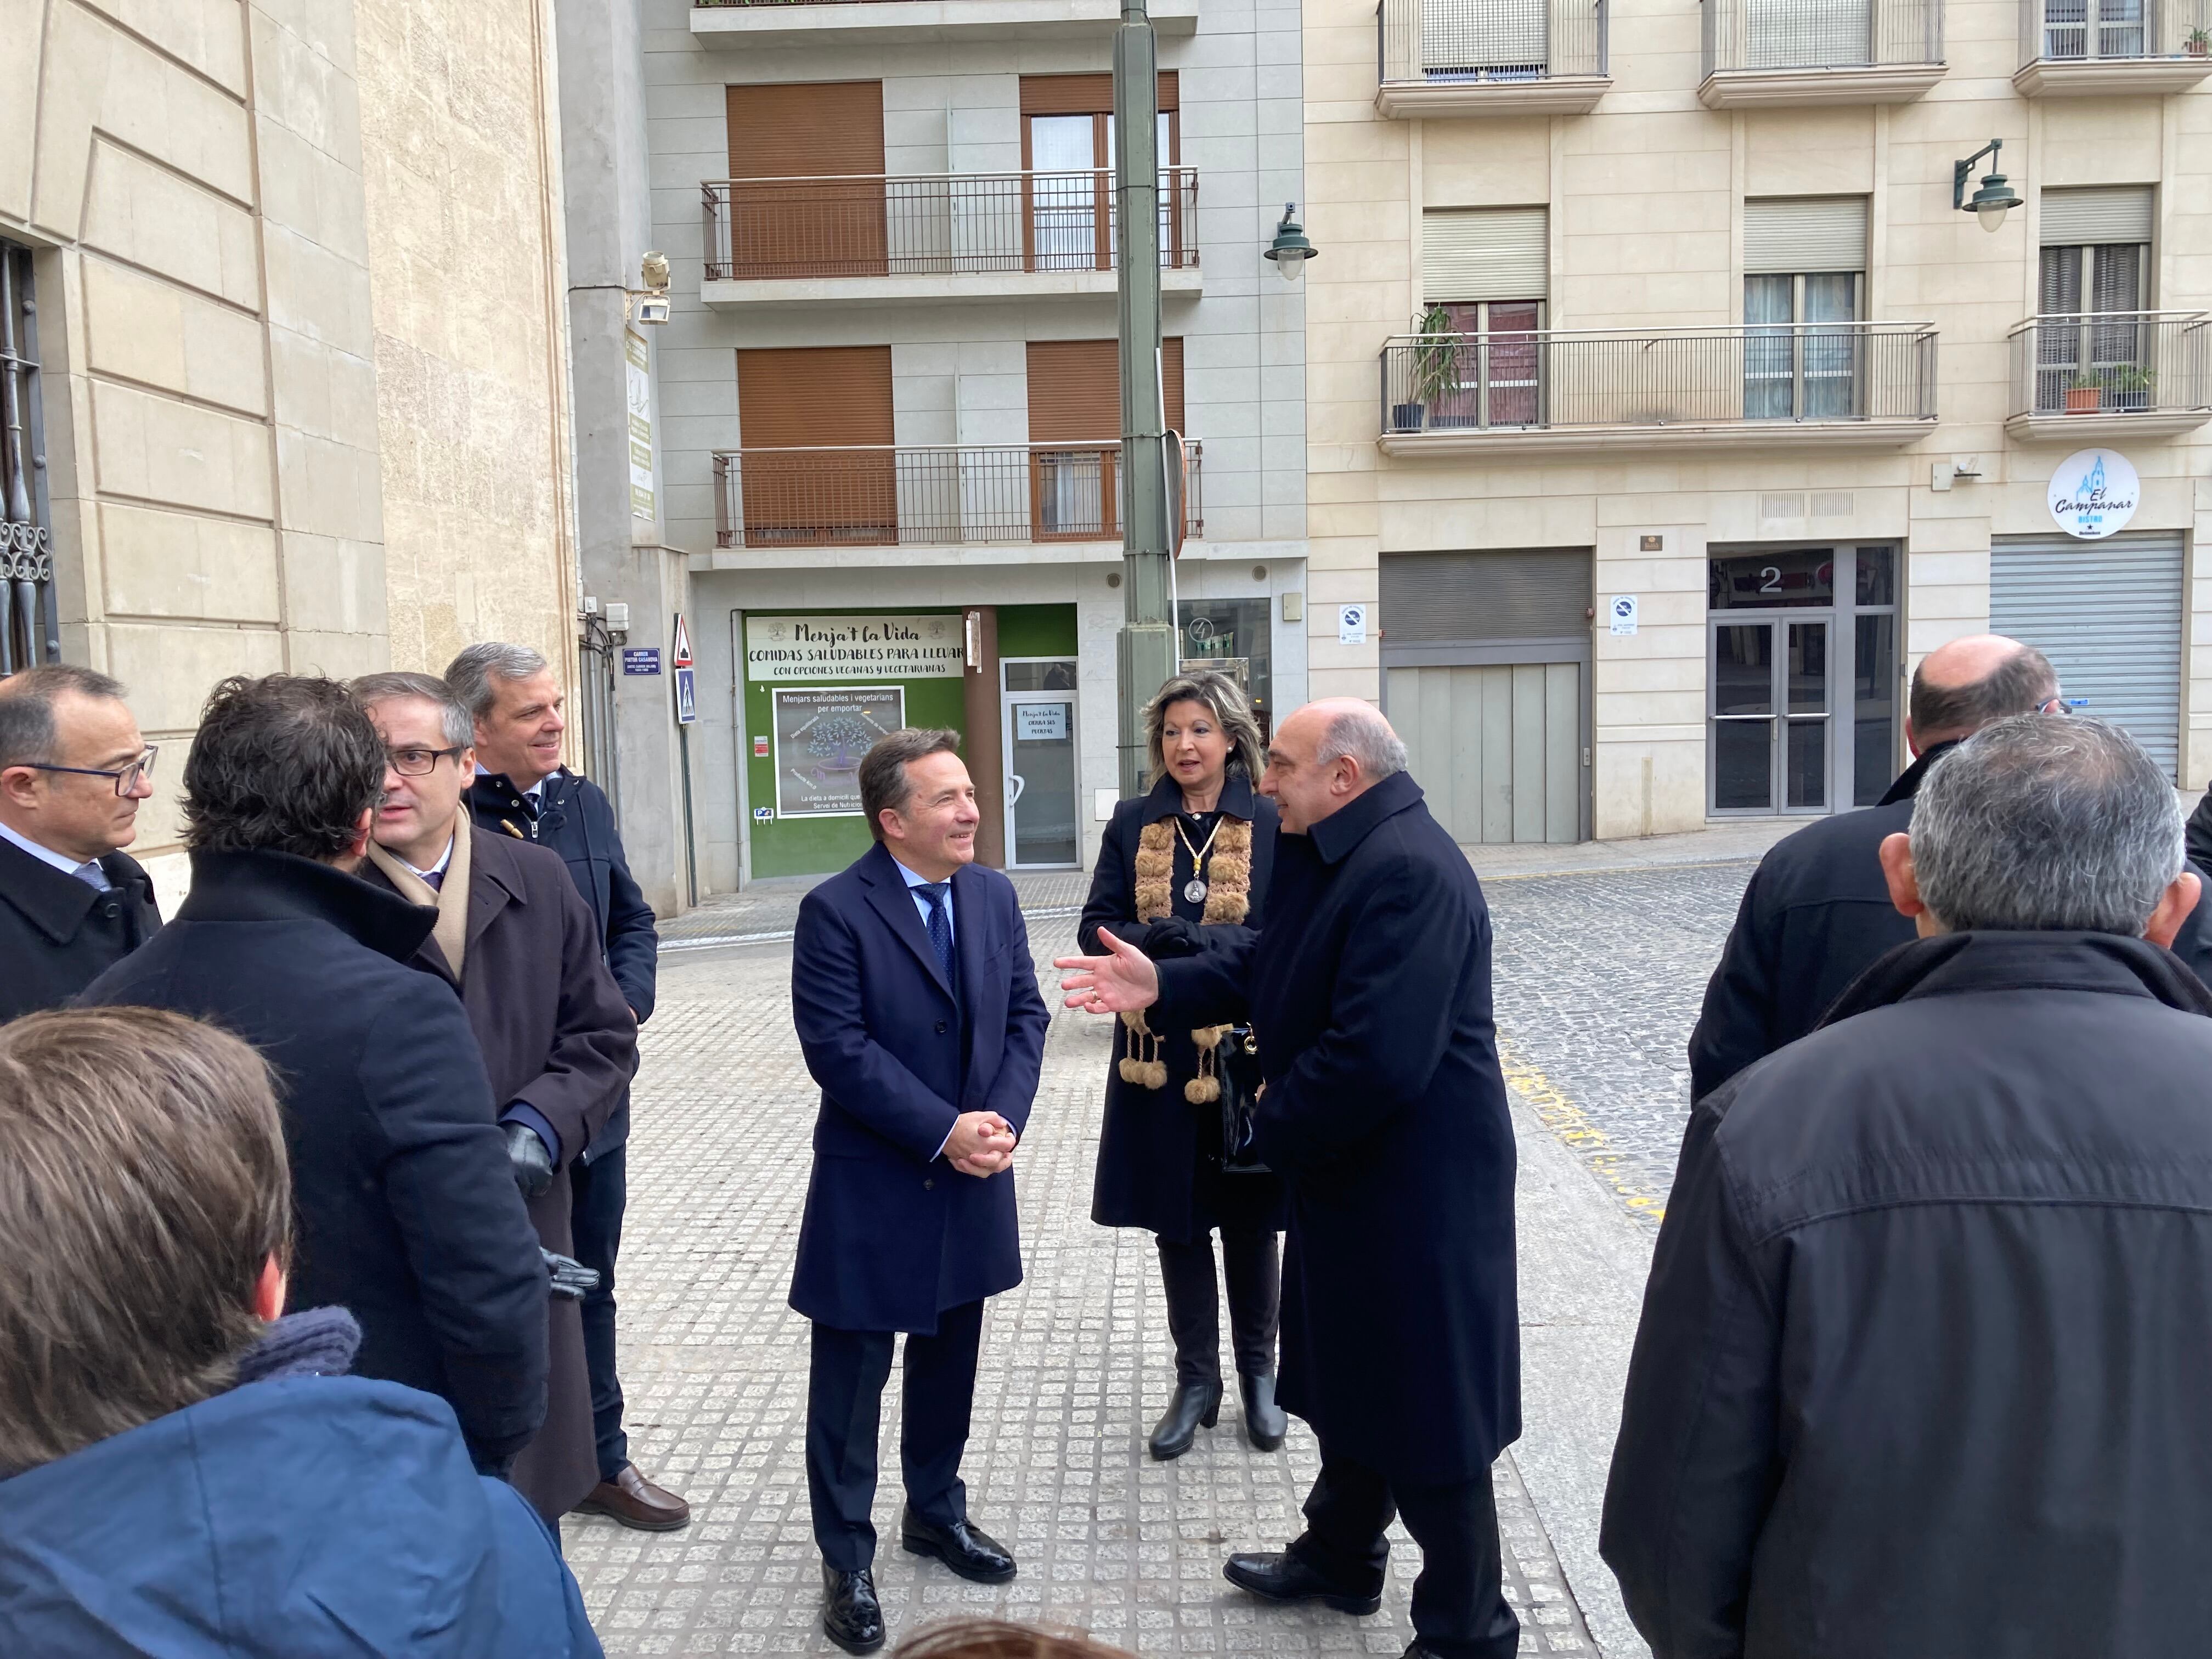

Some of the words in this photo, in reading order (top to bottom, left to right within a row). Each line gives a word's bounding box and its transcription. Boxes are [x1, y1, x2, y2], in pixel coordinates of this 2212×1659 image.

[2090, 487, 2107, 501] El
[2055, 499, 2132, 515] Campanar
[2078, 515, 2102, 523] BISTRO
[1760, 566, 1782, 593] 2
[795, 623, 859, 648] Menja't
[883, 622, 922, 641] Vida
[1195, 621, 1206, 639] 4
[749, 649, 803, 662] COMIDAS
[807, 648, 883, 661] SALUDABLES
[887, 647, 919, 660] PARA
[923, 646, 964, 659] LLEVAR
[774, 667, 791, 675] CON
[793, 665, 833, 675] OPCIONES
[836, 664, 874, 675] VEGANAS
[884, 663, 945, 674] VEGETARIANAS
[783, 695, 811, 704] Menjars
[812, 694, 849, 703] saludables
[854, 693, 894, 703] vegetarians
[831, 704, 862, 713] emportar
